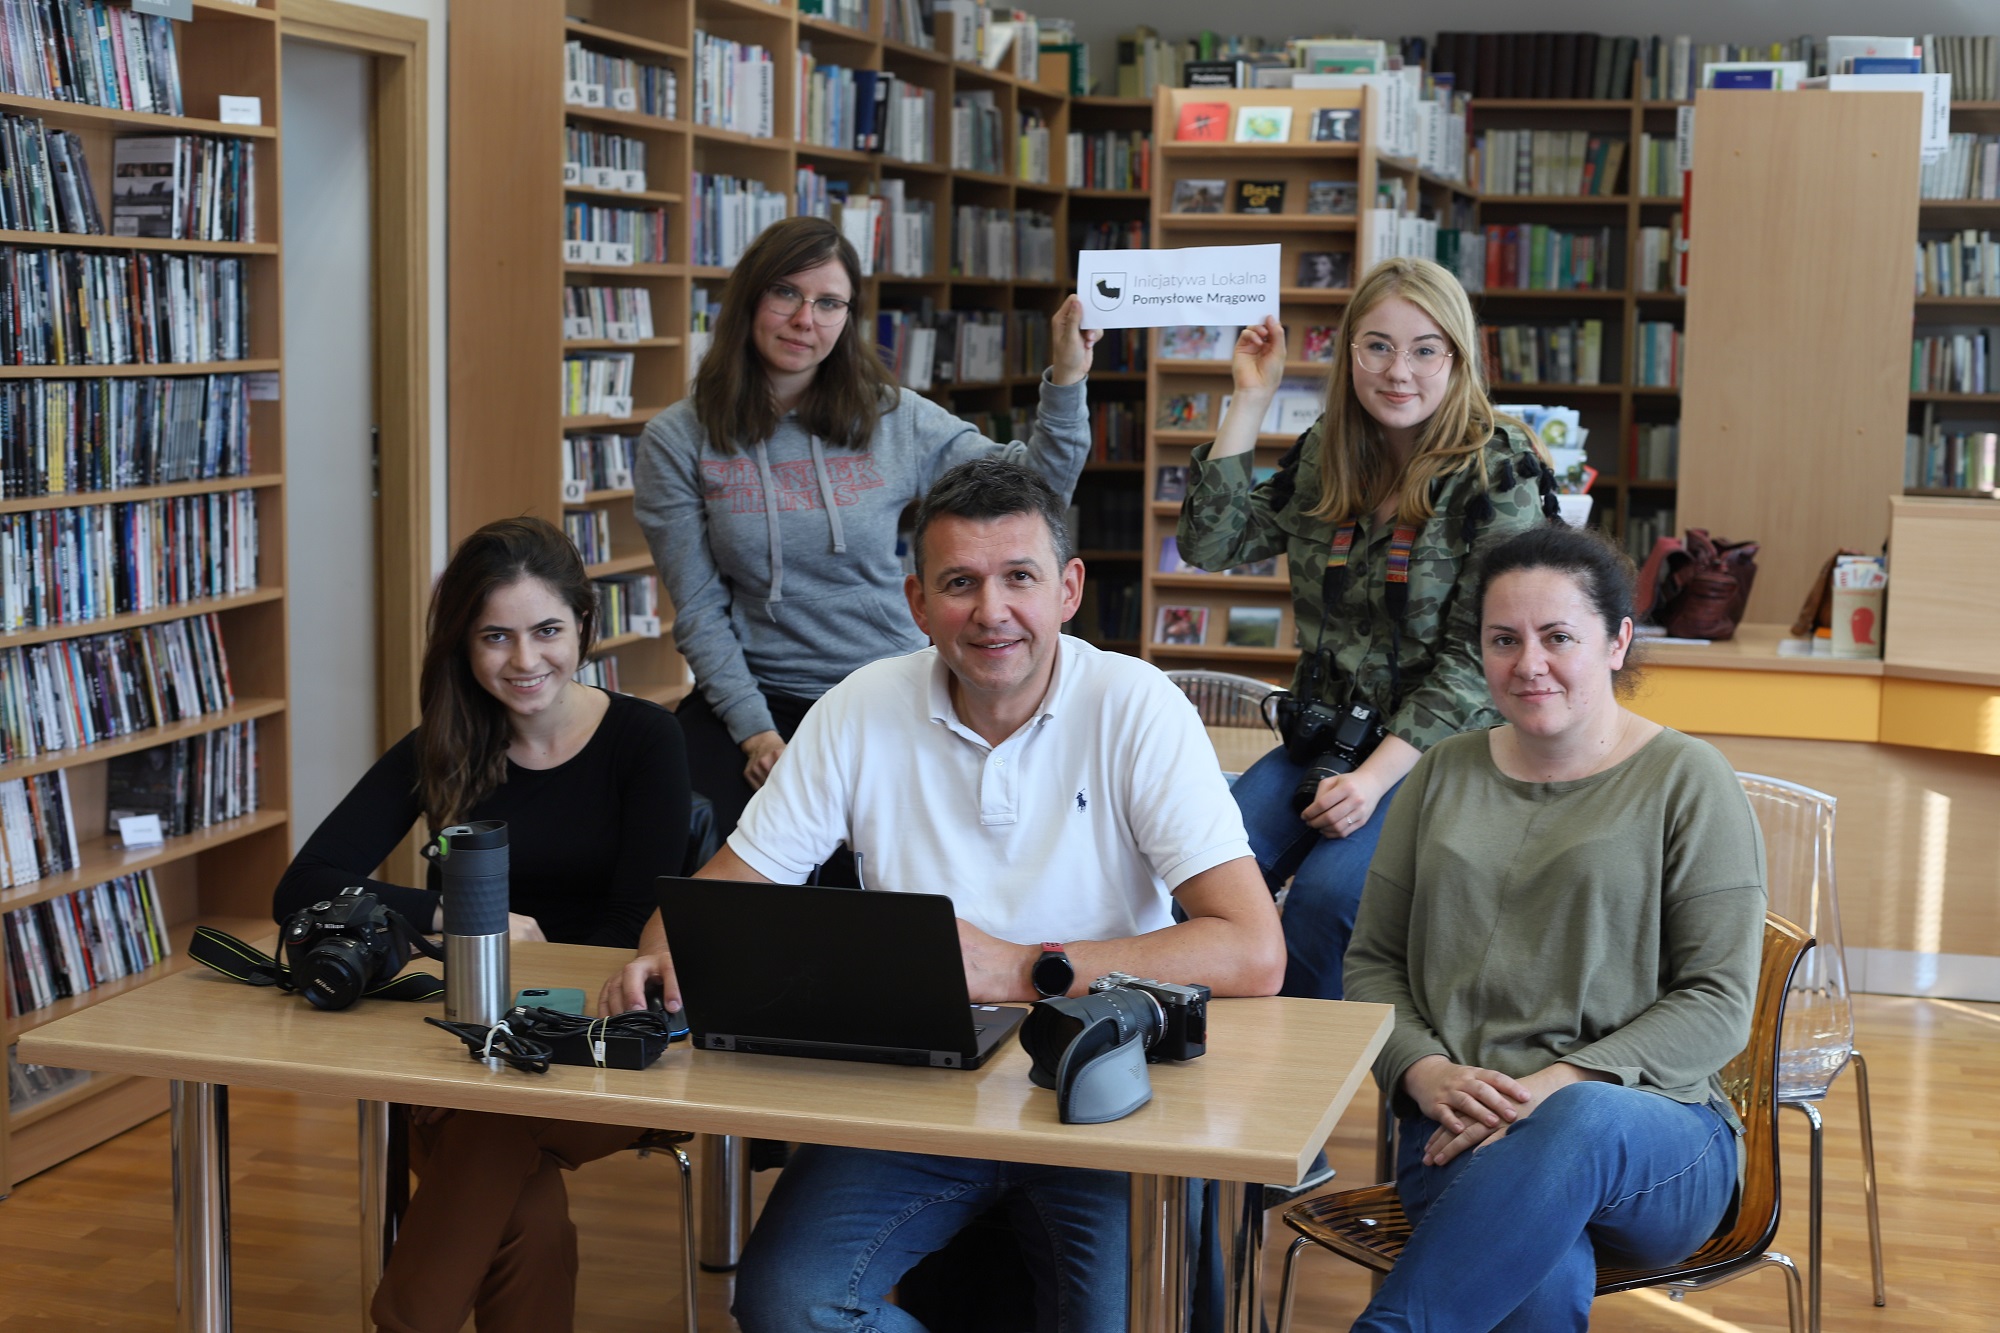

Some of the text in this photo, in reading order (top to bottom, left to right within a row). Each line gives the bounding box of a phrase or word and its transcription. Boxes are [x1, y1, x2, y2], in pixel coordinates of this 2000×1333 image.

[569, 85, 583, 99] A
[587, 89, 599, 103] B
[618, 91, 631, 106] C
[564, 167, 576, 180] D
[597, 171, 610, 185] E
[625, 175, 637, 188] F
[568, 244, 581, 259] H
[595, 246, 602, 260] I
[615, 248, 628, 262] K
[1133, 272, 1267, 290] Inicjatywa Lokalna
[1132, 293, 1266, 307] Pomysłowe Mrągowo
[576, 322, 589, 336] L
[566, 484, 580, 499] O
[314, 978, 335, 994] Nikon
